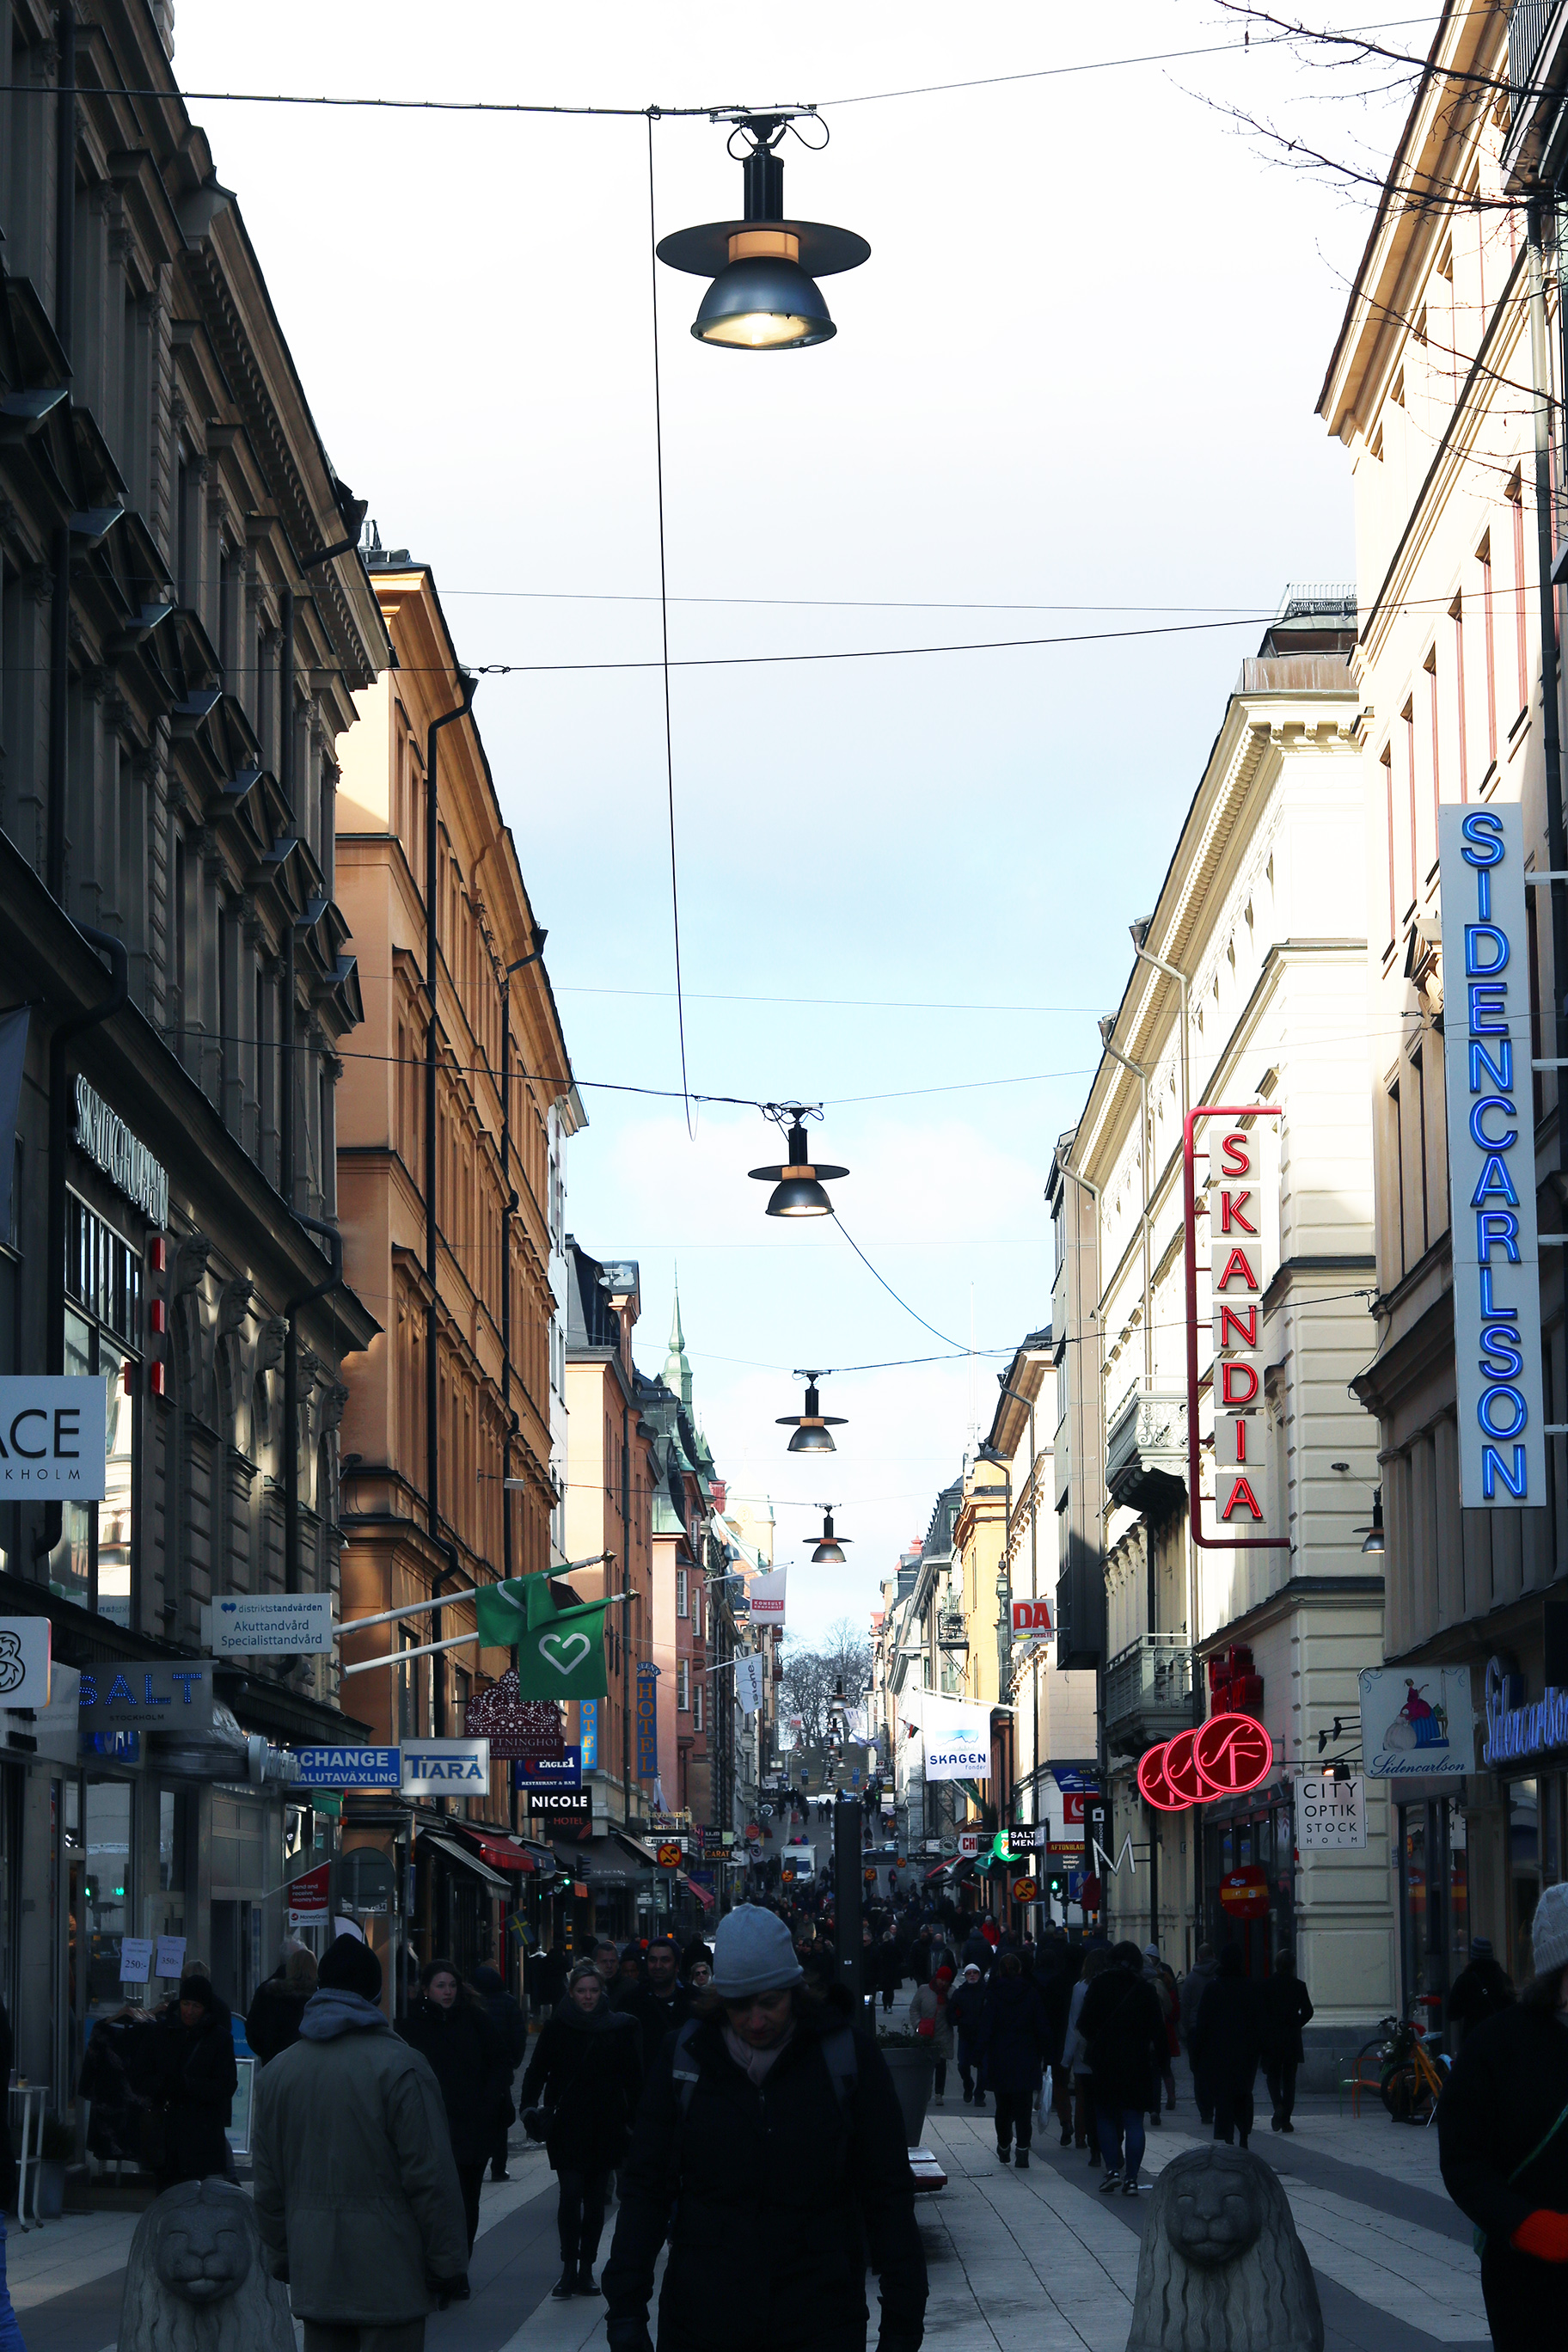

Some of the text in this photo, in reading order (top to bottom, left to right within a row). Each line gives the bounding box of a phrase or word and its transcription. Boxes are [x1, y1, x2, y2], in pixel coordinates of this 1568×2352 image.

[1460, 811, 1529, 1499] SIDENCARLSON
[1219, 1132, 1265, 1520] SKANDIA
[239, 1604, 322, 1613] distriktstandvården
[1013, 1603, 1051, 1631] DA
[234, 1620, 309, 1632] Akuttandvård
[221, 1634, 322, 1648] Specialisttandvård
[79, 1673, 202, 1706] SALT
[582, 1703, 595, 1764] OTEL
[638, 1683, 654, 1772] HOTEL
[490, 1738, 560, 1747] TTNINGHOF
[300, 1752, 389, 1767] CHANGE
[929, 1754, 986, 1765] SKAGEN
[1370, 1755, 1466, 1775] Sidencarlson
[300, 1771, 398, 1783] ALUTAVÄXLING
[1303, 1782, 1357, 1798] CITY
[531, 1796, 588, 1808] NICOLE
[1304, 1804, 1357, 1817] OPTIK
[1306, 1822, 1357, 1833] STOCK
[125, 1960, 147, 1969] 250:-
